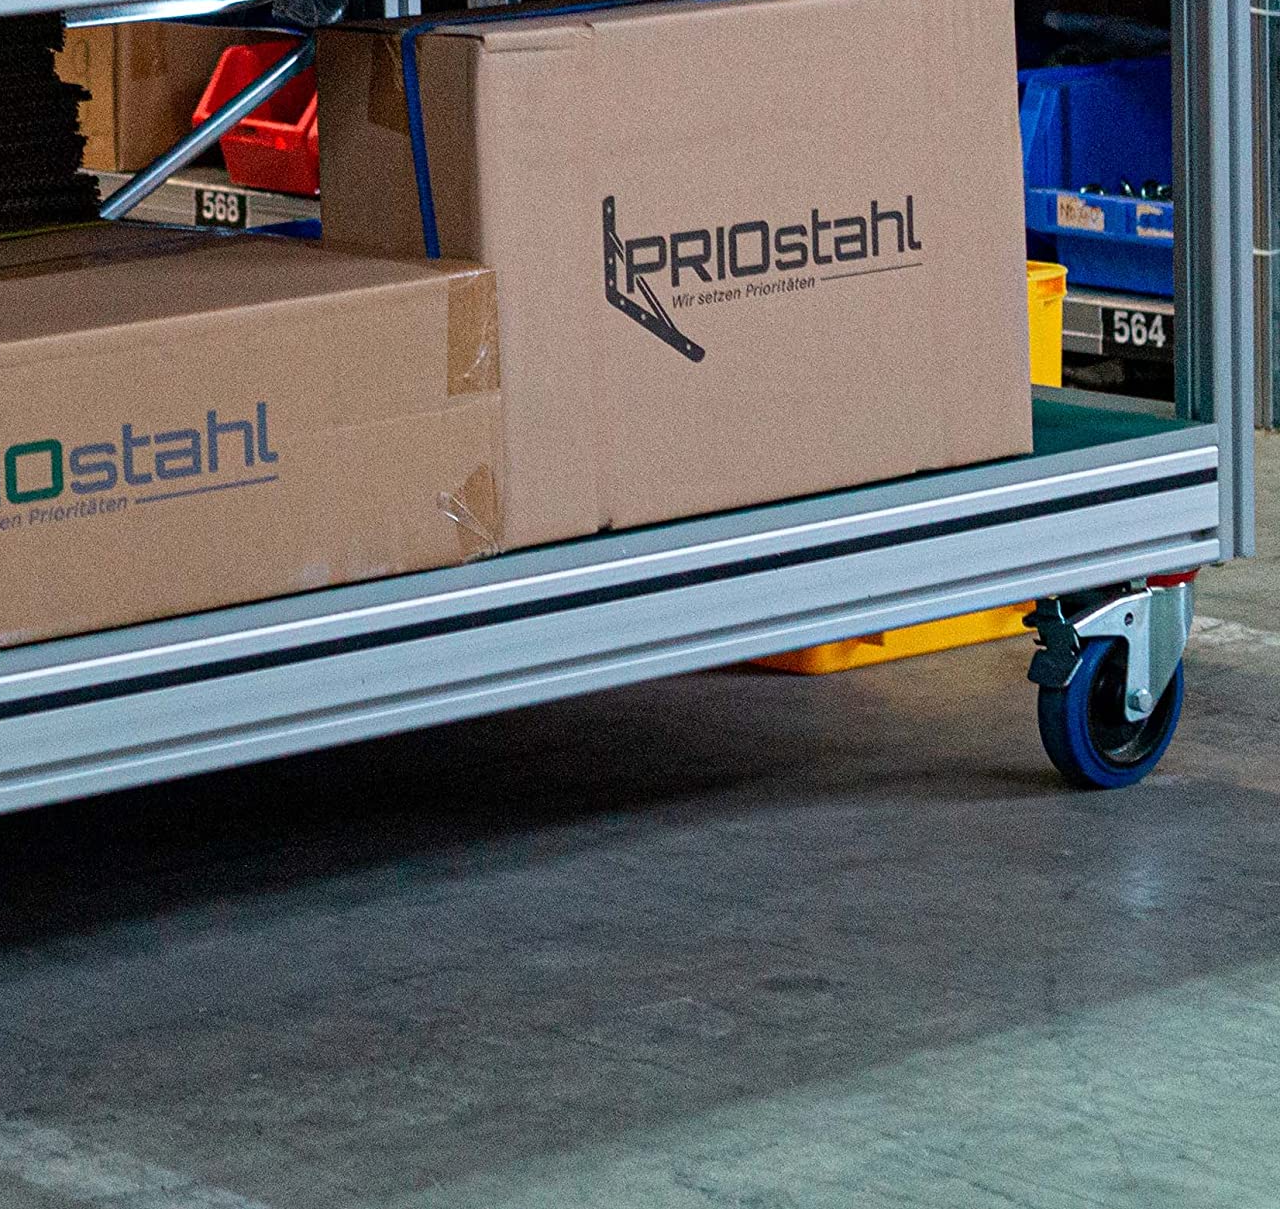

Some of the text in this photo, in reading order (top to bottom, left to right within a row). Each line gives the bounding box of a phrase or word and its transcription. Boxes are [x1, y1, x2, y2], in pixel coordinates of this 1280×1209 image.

[202, 192, 240, 223] 568
[625, 195, 922, 294] PRIOstahl
[671, 276, 815, 310] Wir setzen Prioritäten
[1113, 311, 1167, 348] 564
[28, 496, 128, 525] Prioritäten
